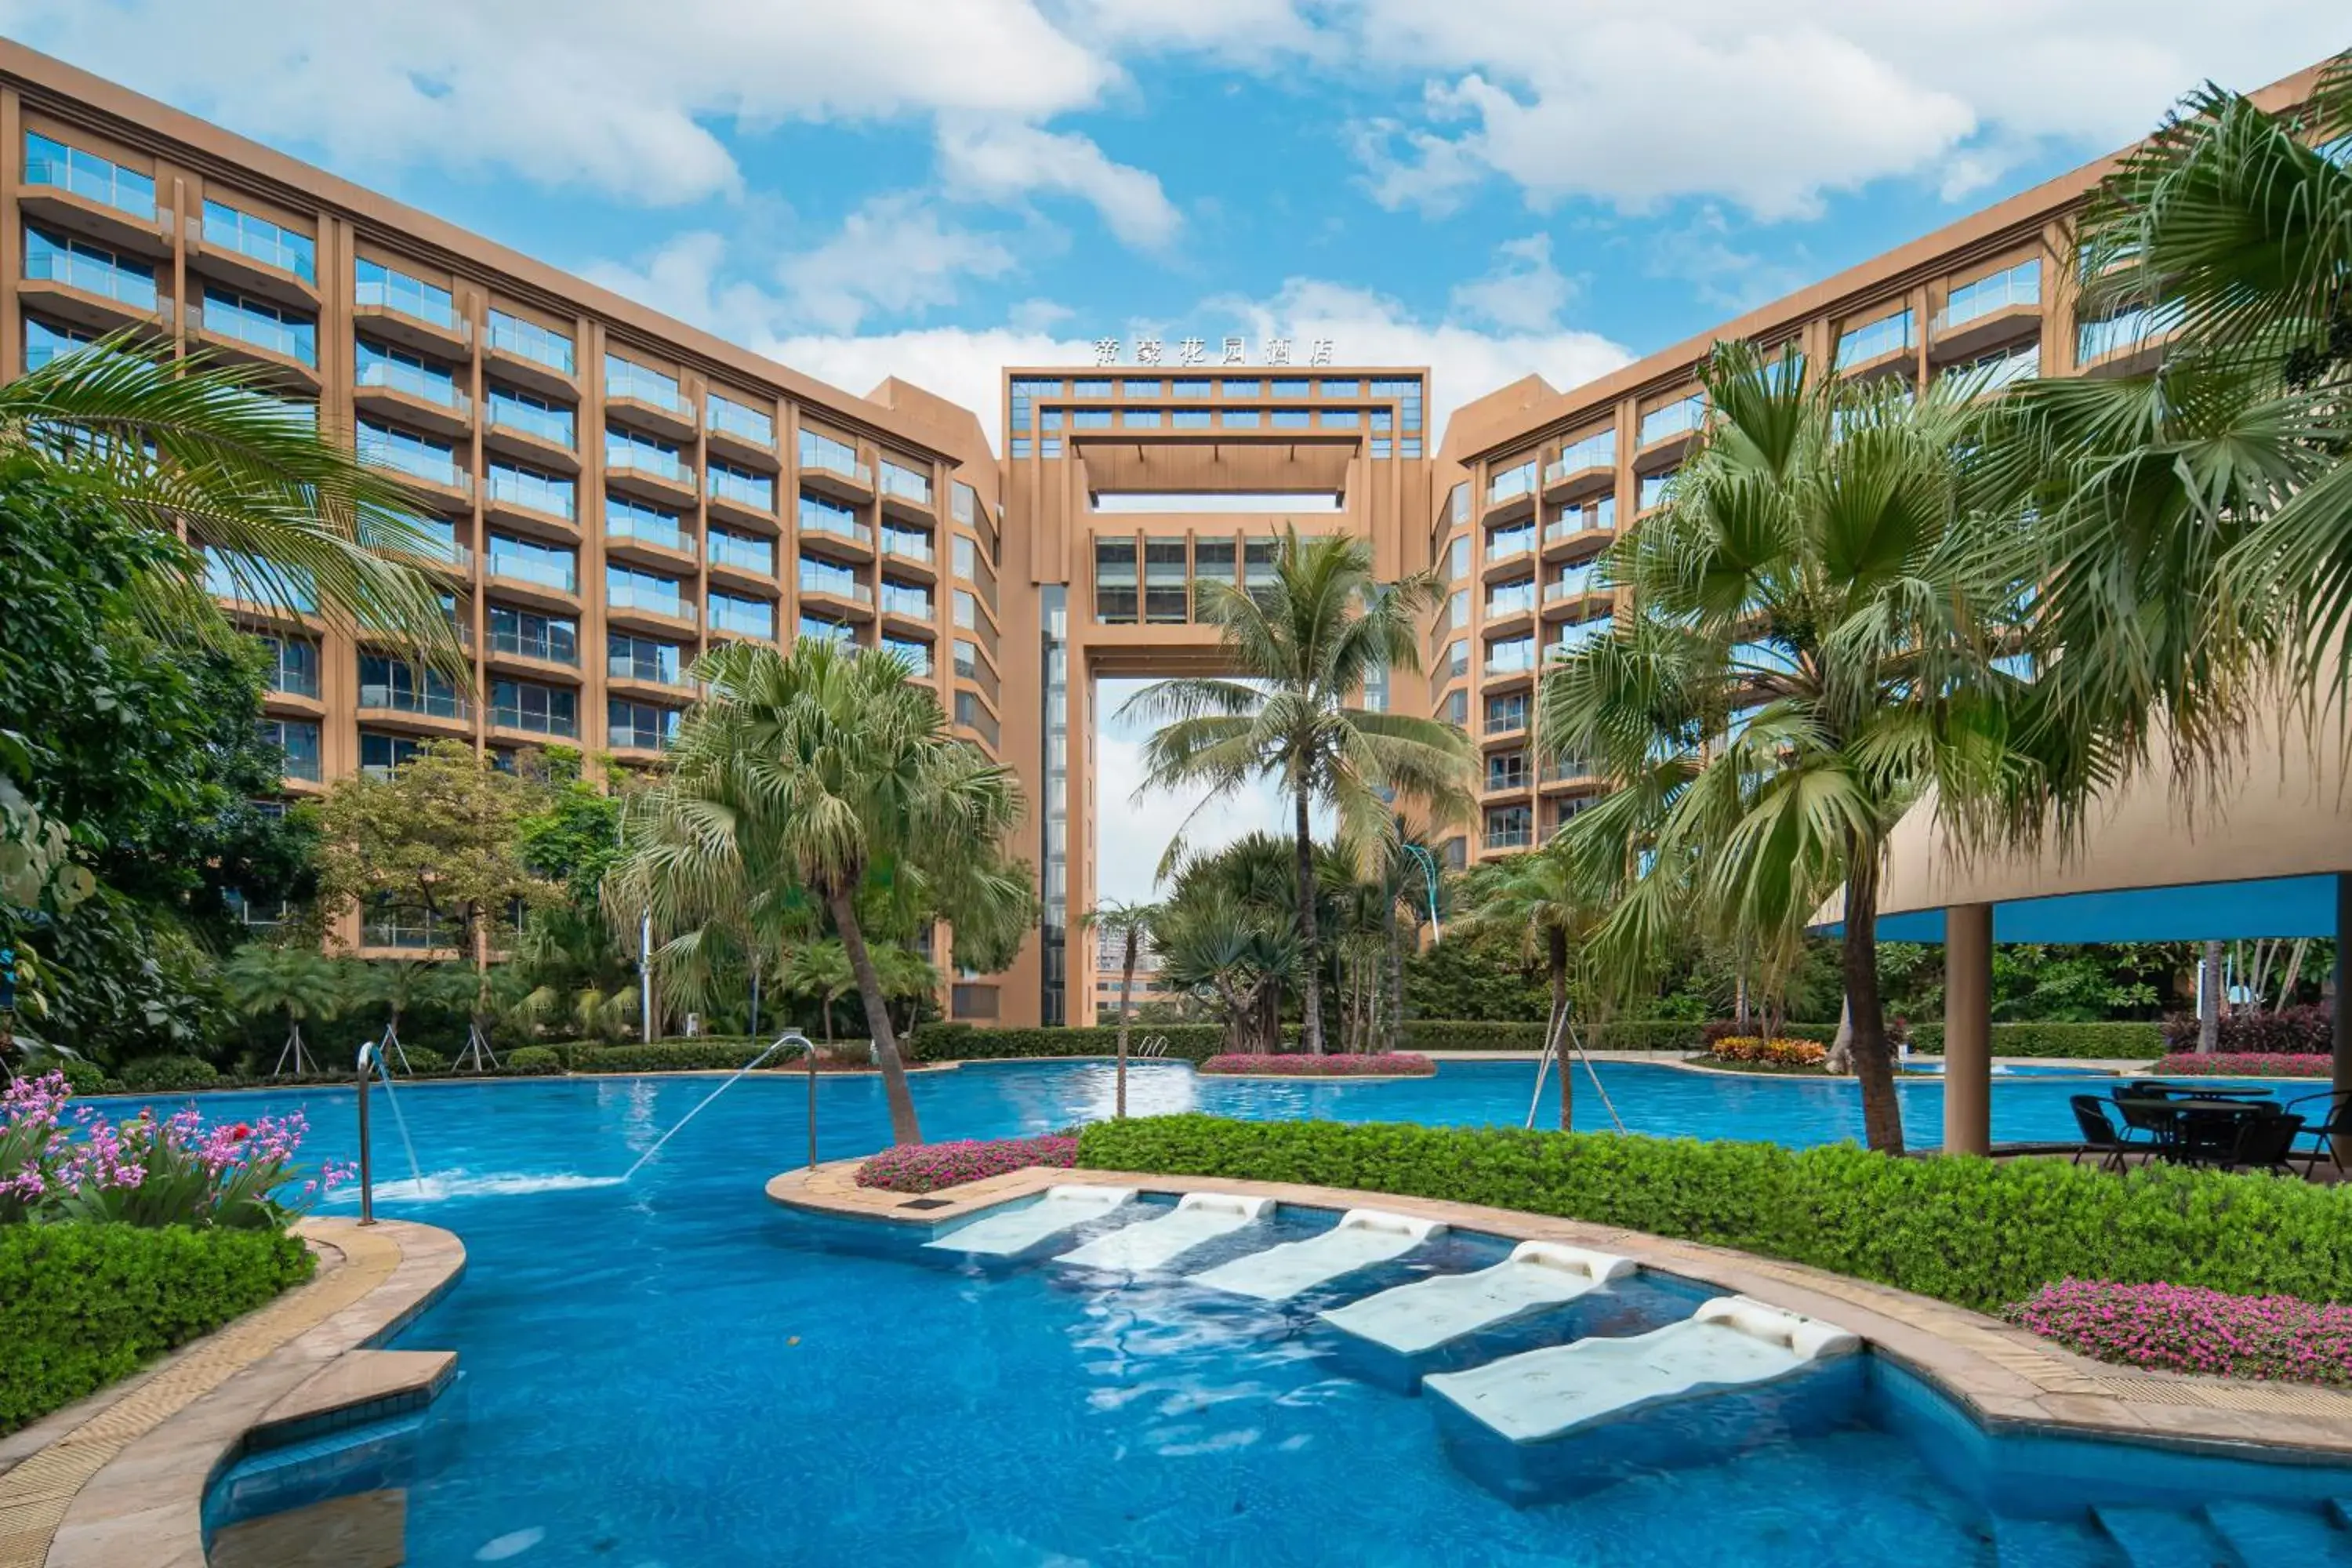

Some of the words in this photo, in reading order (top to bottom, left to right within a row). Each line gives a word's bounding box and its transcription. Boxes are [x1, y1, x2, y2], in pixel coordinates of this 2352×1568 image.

[1094, 337, 1334, 365] 帝豪花园酒店
